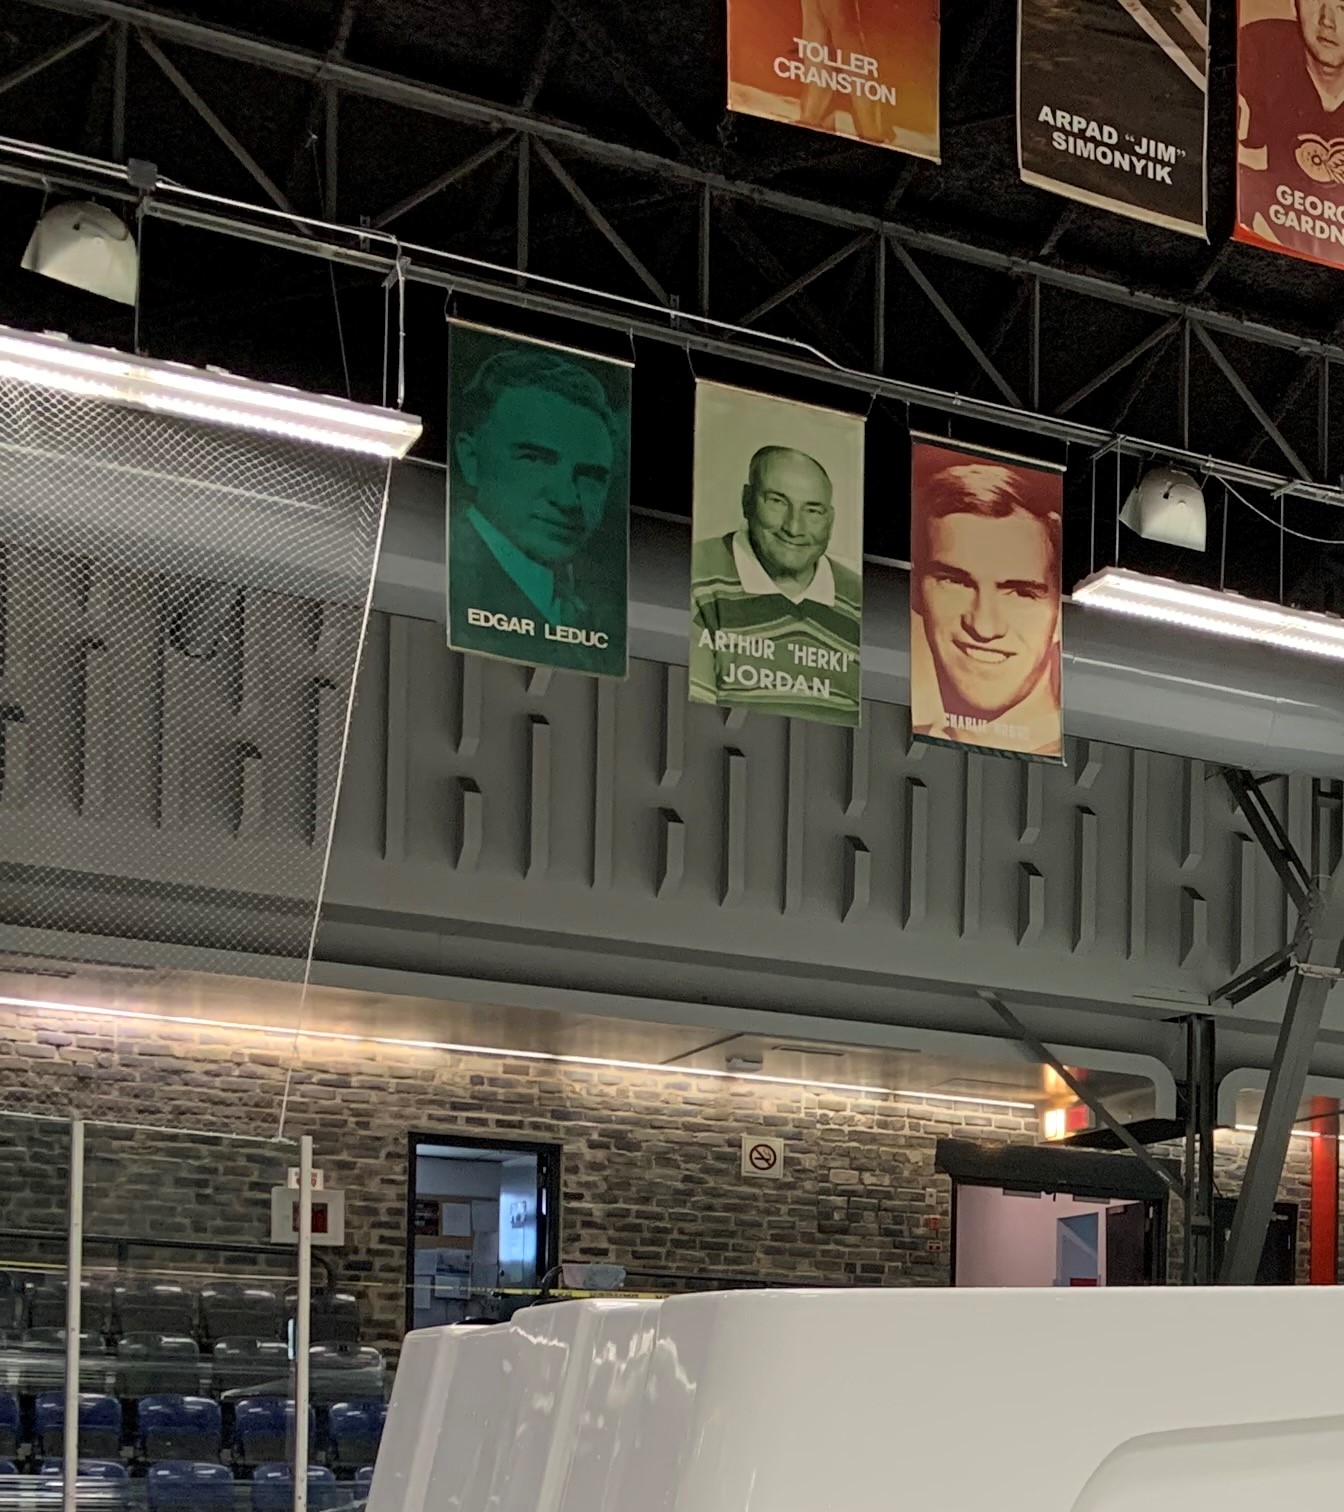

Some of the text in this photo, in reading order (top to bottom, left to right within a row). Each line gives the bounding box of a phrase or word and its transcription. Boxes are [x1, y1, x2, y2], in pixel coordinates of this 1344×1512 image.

[793, 37, 878, 78] TOLLER
[774, 57, 896, 106] CRANSTON
[1038, 105, 1119, 145] ARPAD
[1052, 131, 1173, 185] SIMONYIK
[468, 608, 609, 649] EDGAR LEDUC
[698, 628, 855, 672] ARTHUR "HERKI"
[722, 663, 830, 699] JORDAN
